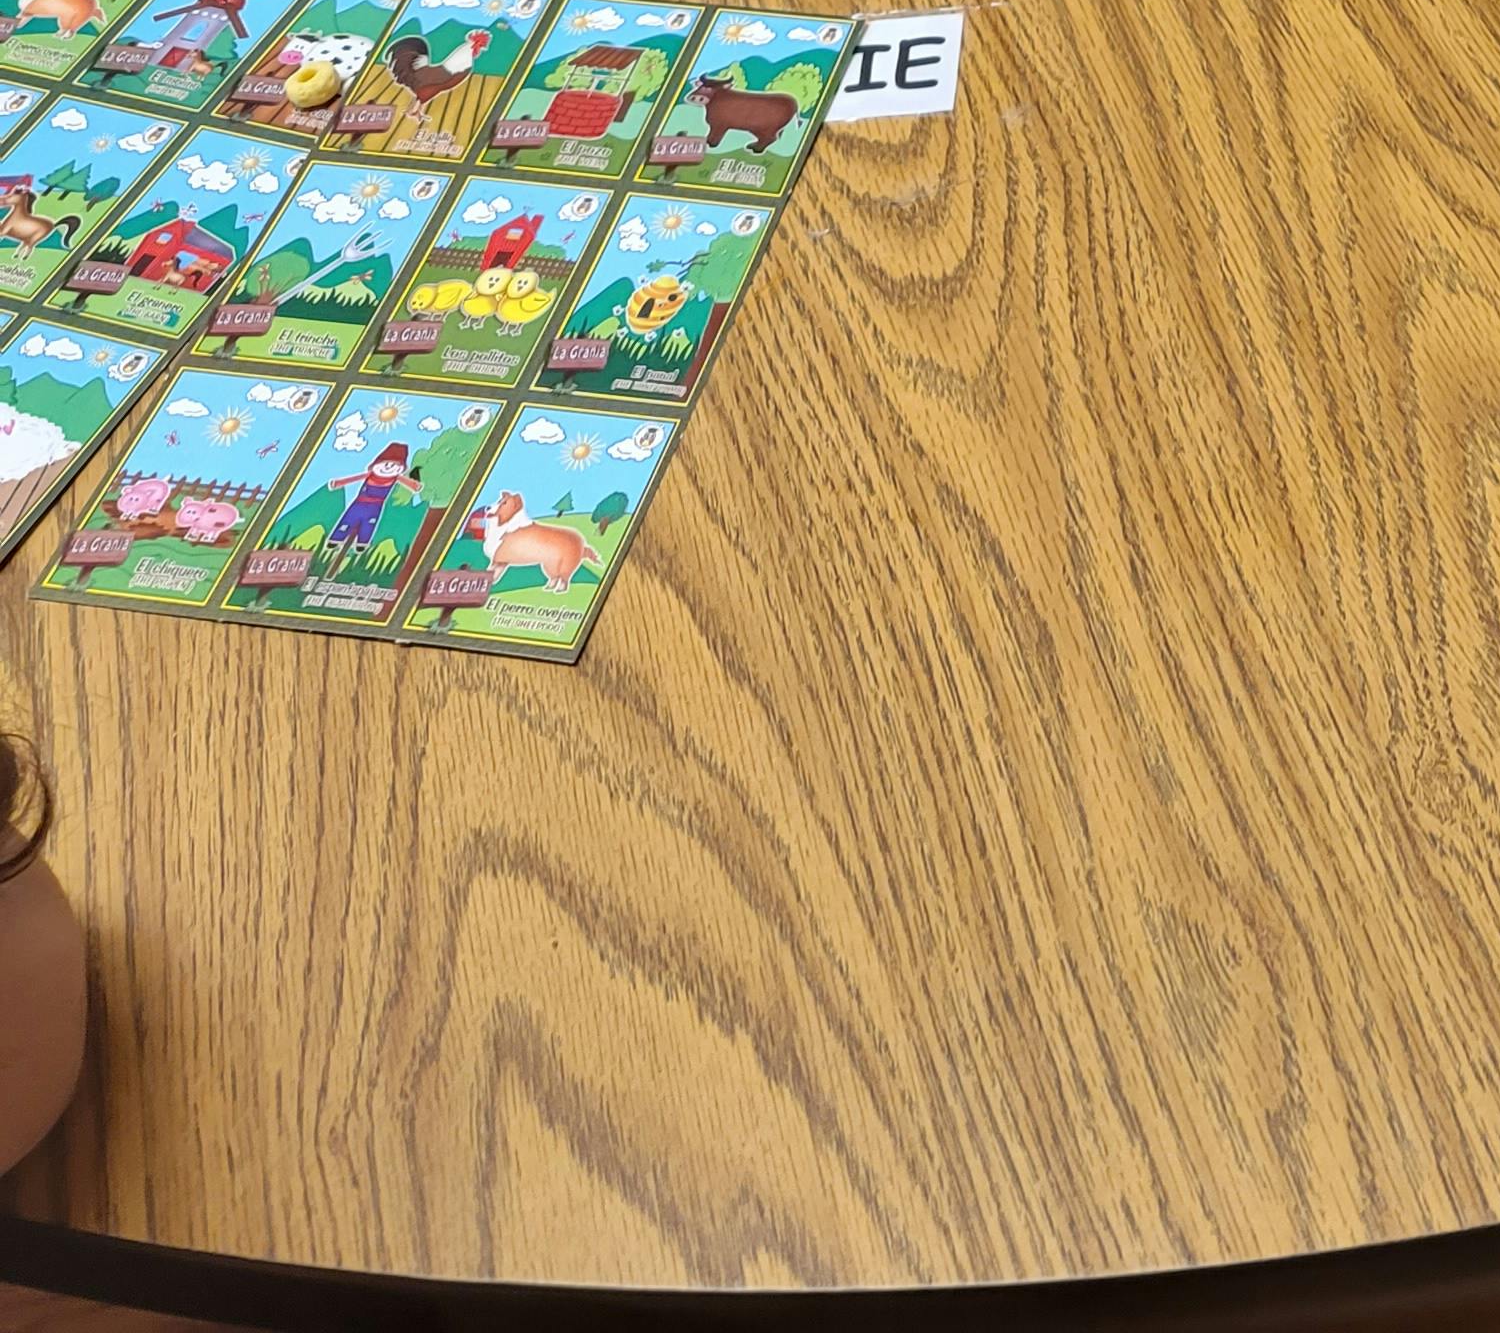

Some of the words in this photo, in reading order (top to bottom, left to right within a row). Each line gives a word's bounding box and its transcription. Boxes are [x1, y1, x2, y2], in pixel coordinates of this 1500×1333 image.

[216, 309, 233, 325] La
[552, 344, 569, 360] La
[71, 537, 88, 552] La
[248, 556, 266, 574] La
[429, 579, 445, 595] La
